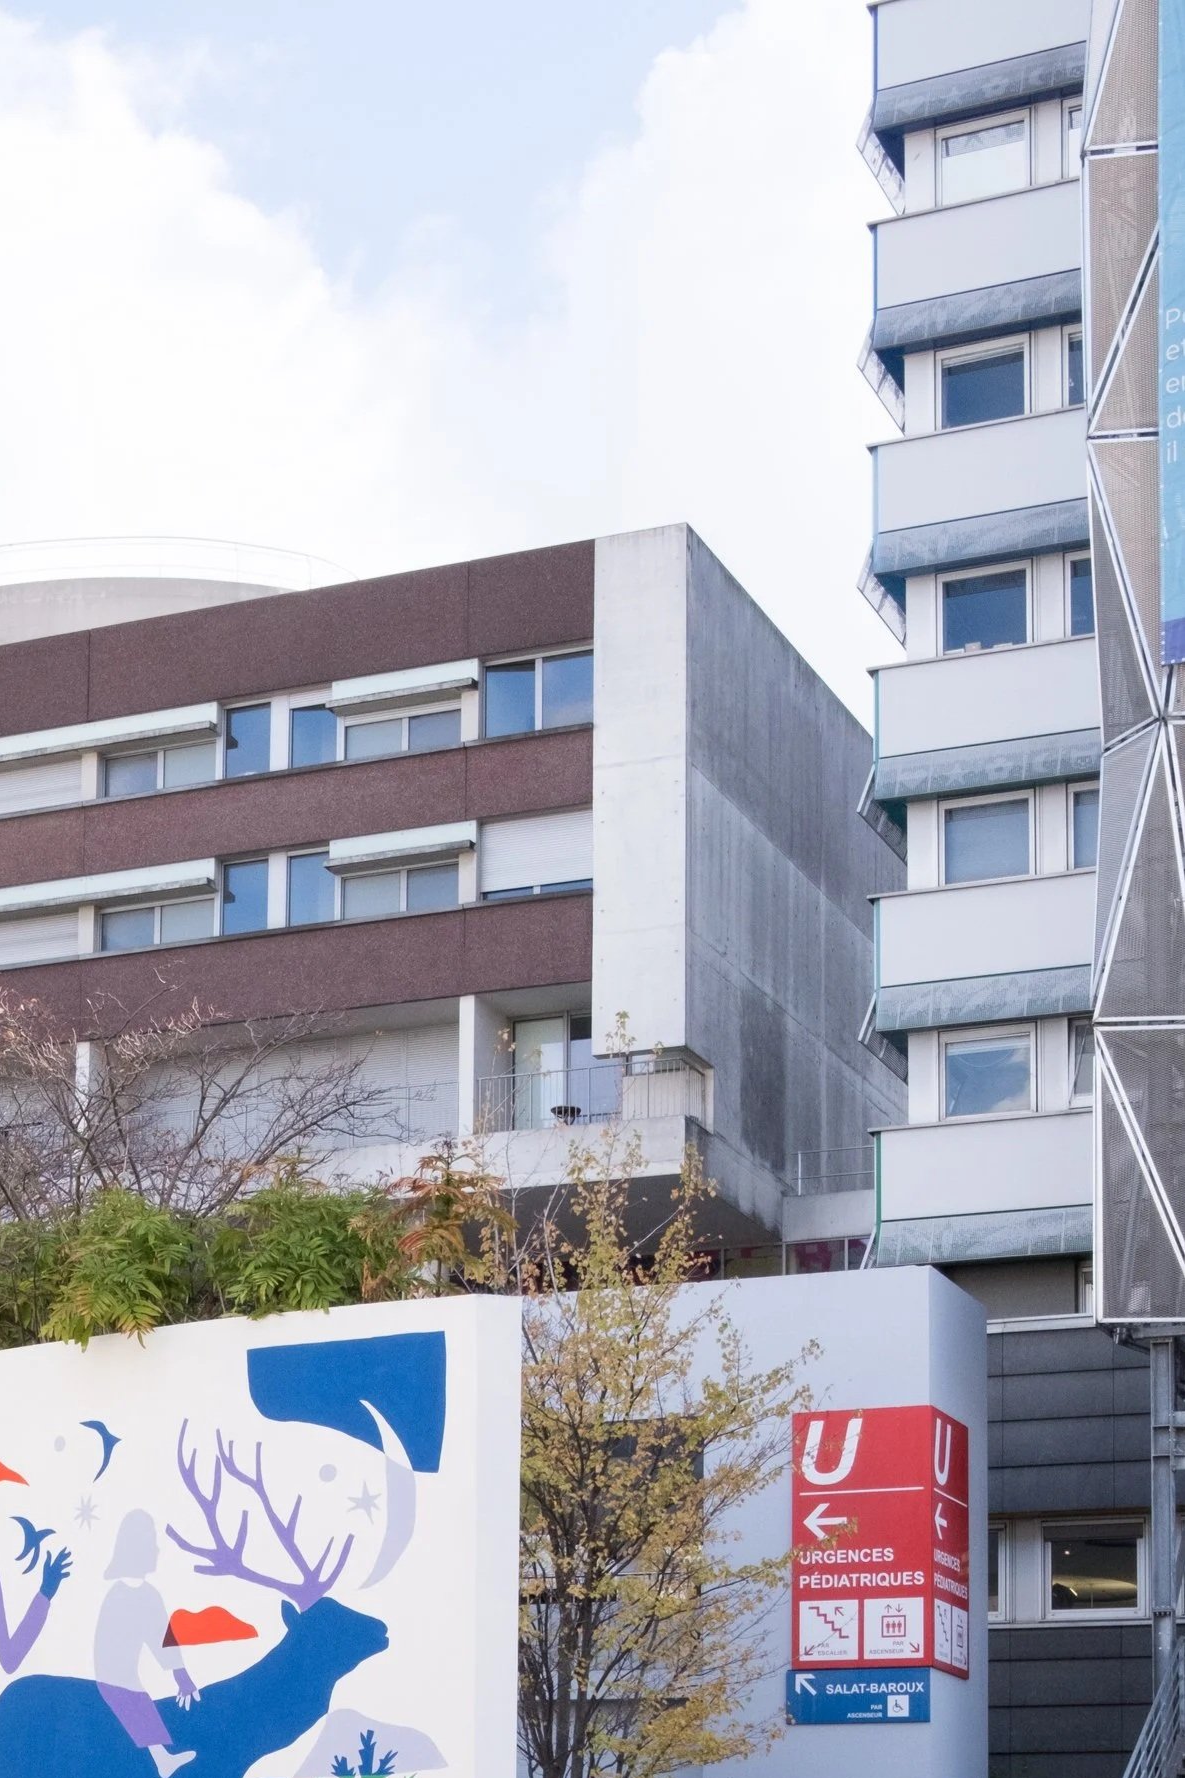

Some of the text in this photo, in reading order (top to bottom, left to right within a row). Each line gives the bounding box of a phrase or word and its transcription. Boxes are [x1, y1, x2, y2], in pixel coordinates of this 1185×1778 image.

[1165, 307, 1185, 330] P
[1166, 405, 1185, 429] d
[1167, 440, 1177, 464] il
[801, 1417, 863, 1486] U
[934, 1418, 951, 1486] U
[799, 1547, 894, 1565] URGENCES
[933, 1547, 961, 1574] URGENCES
[799, 1570, 925, 1590] PÉDIATRIQUES
[933, 1570, 969, 1601] PÉDIATRIQUES
[825, 1681, 925, 1695] SALAT-BAROUX
